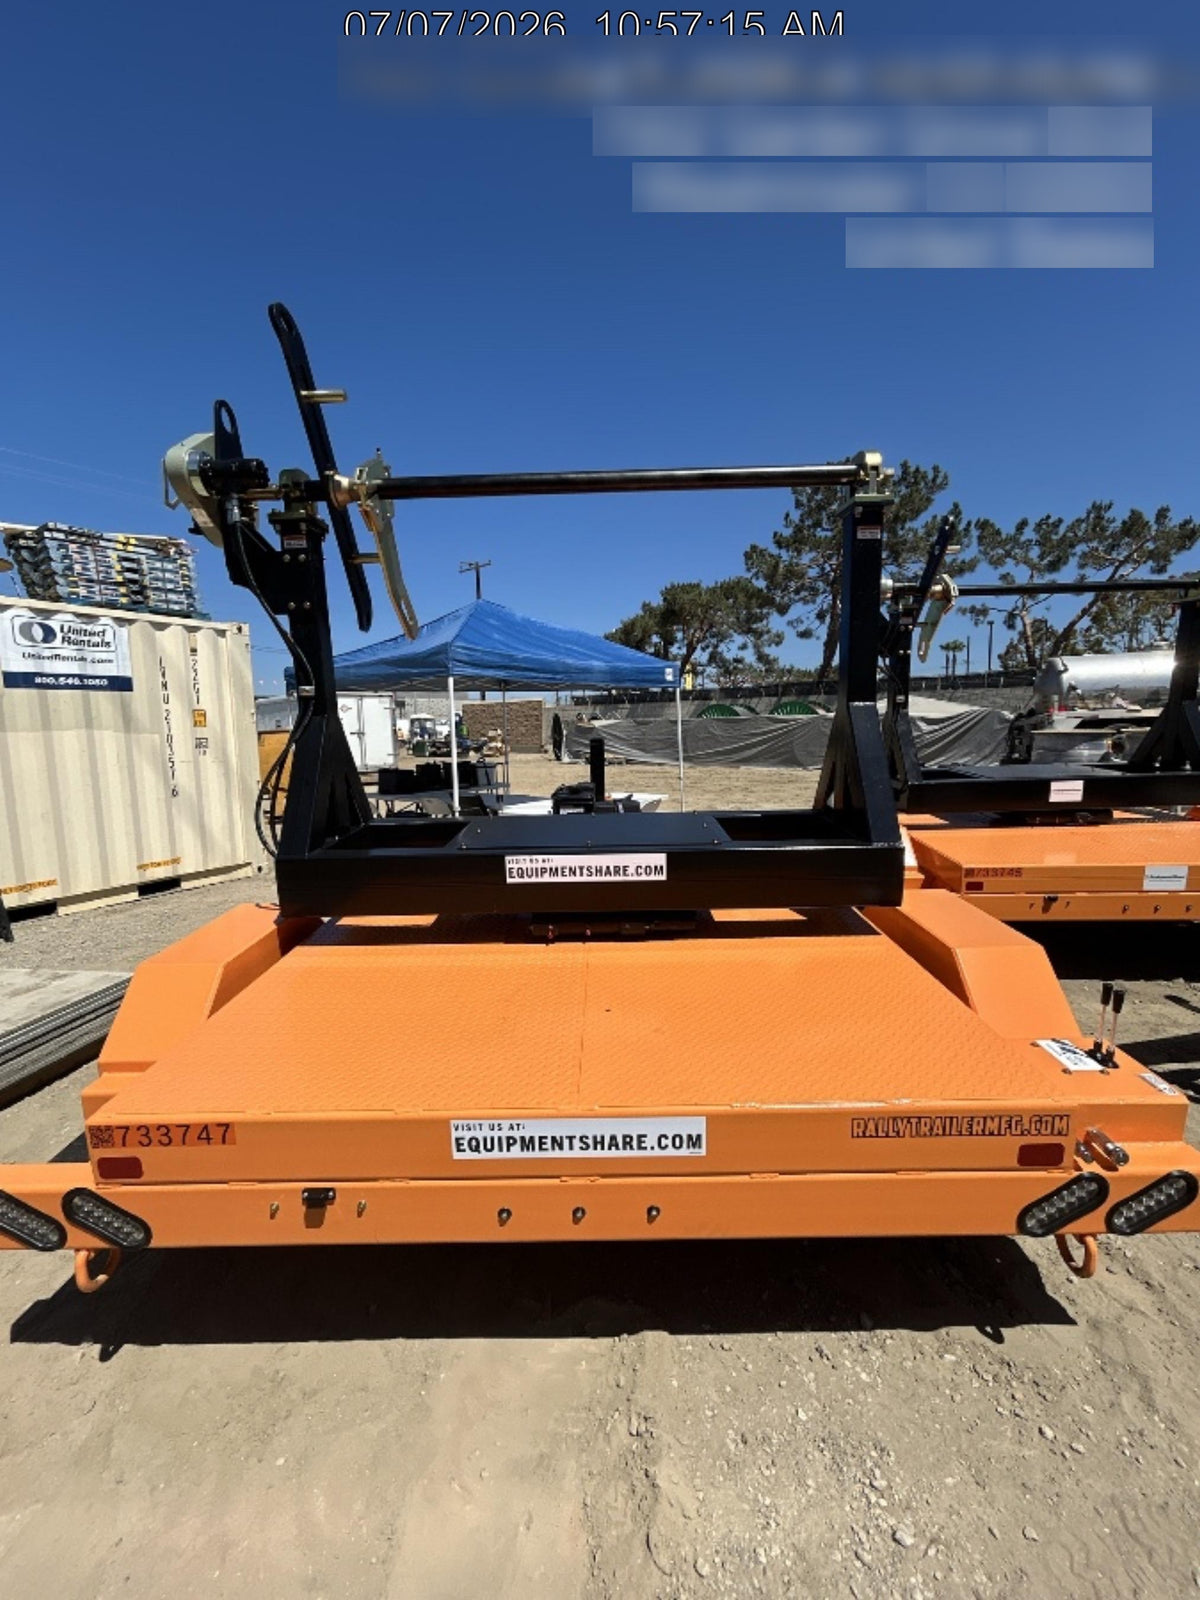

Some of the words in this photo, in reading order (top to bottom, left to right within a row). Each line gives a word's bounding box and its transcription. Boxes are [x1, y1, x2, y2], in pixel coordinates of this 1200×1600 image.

[60, 625, 106, 637] United
[61, 636, 112, 648] Rentals
[508, 865, 664, 878] EQUIPMENTSHARE.COM
[453, 1123, 484, 1132] VISIT
[488, 1122, 504, 1131] US
[851, 1114, 1071, 1139] RALLYTRAILERMFG.COM
[115, 1123, 231, 1147] 733747
[454, 1133, 703, 1153] EQUIPMENTSHARE.COM
